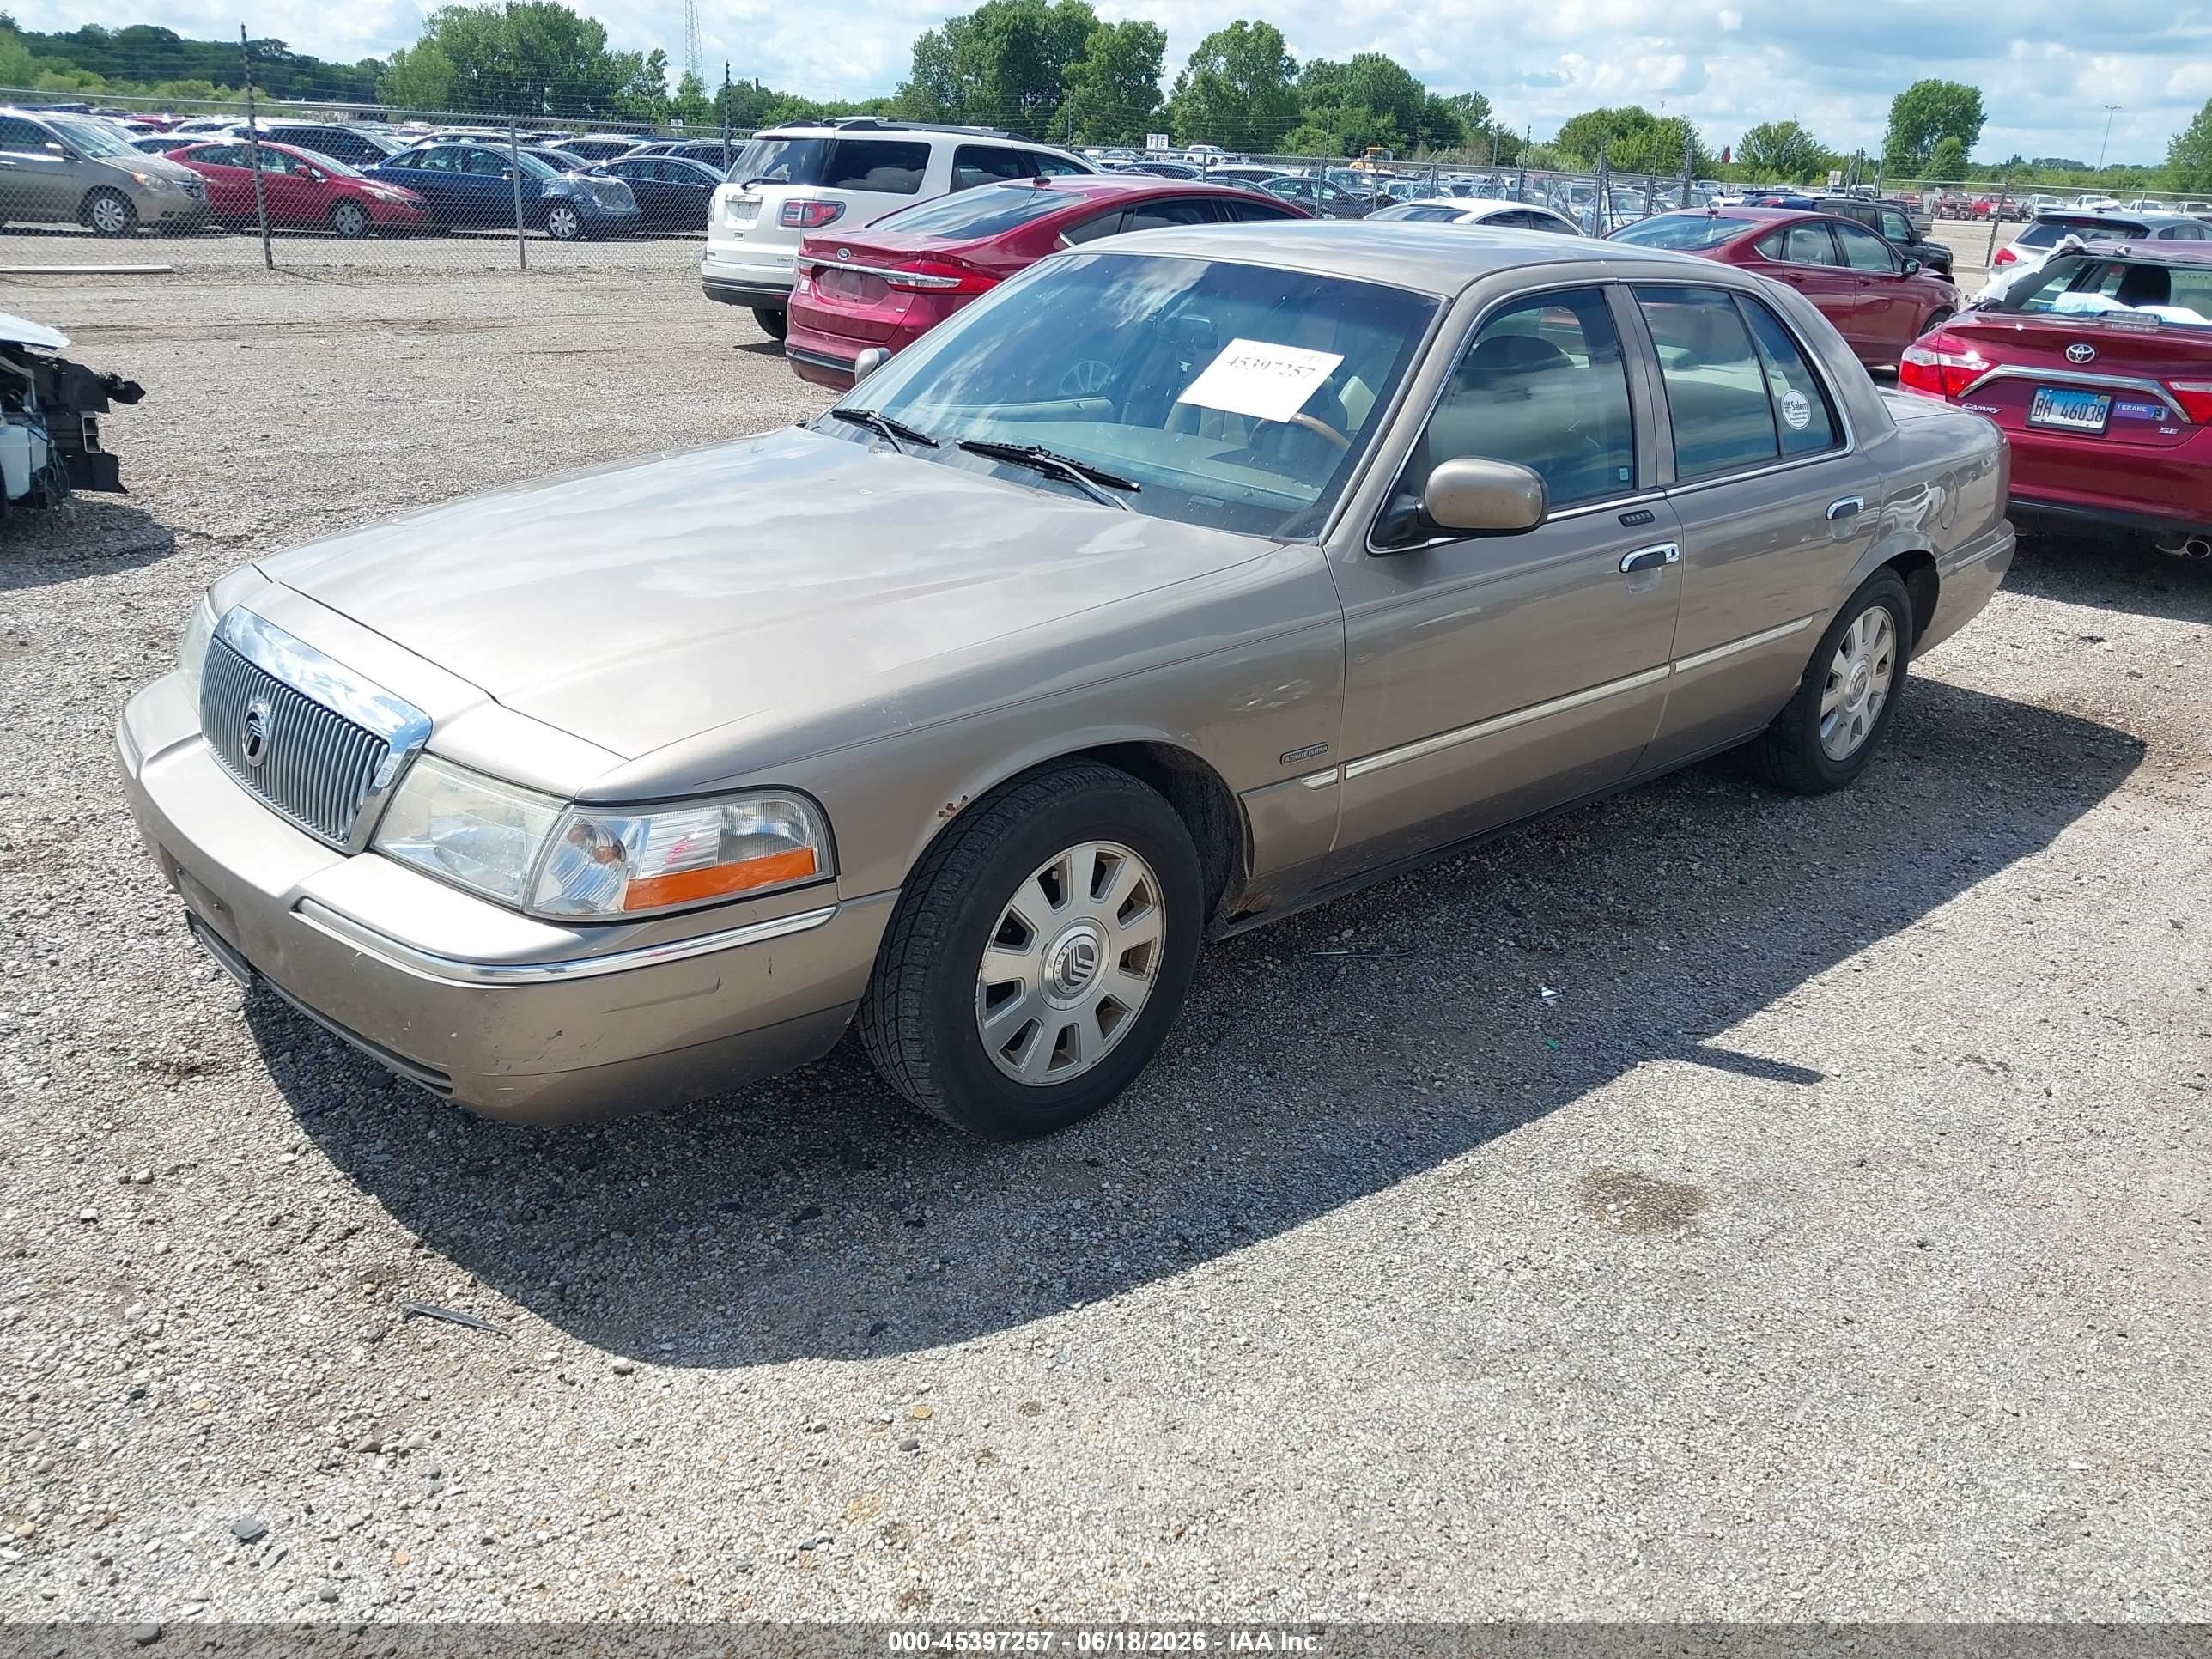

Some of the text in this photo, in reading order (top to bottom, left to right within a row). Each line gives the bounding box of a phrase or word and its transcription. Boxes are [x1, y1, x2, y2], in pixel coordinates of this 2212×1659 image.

[1791, 400, 1808, 410] Salem
[2033, 398, 2106, 422] BH 46038
